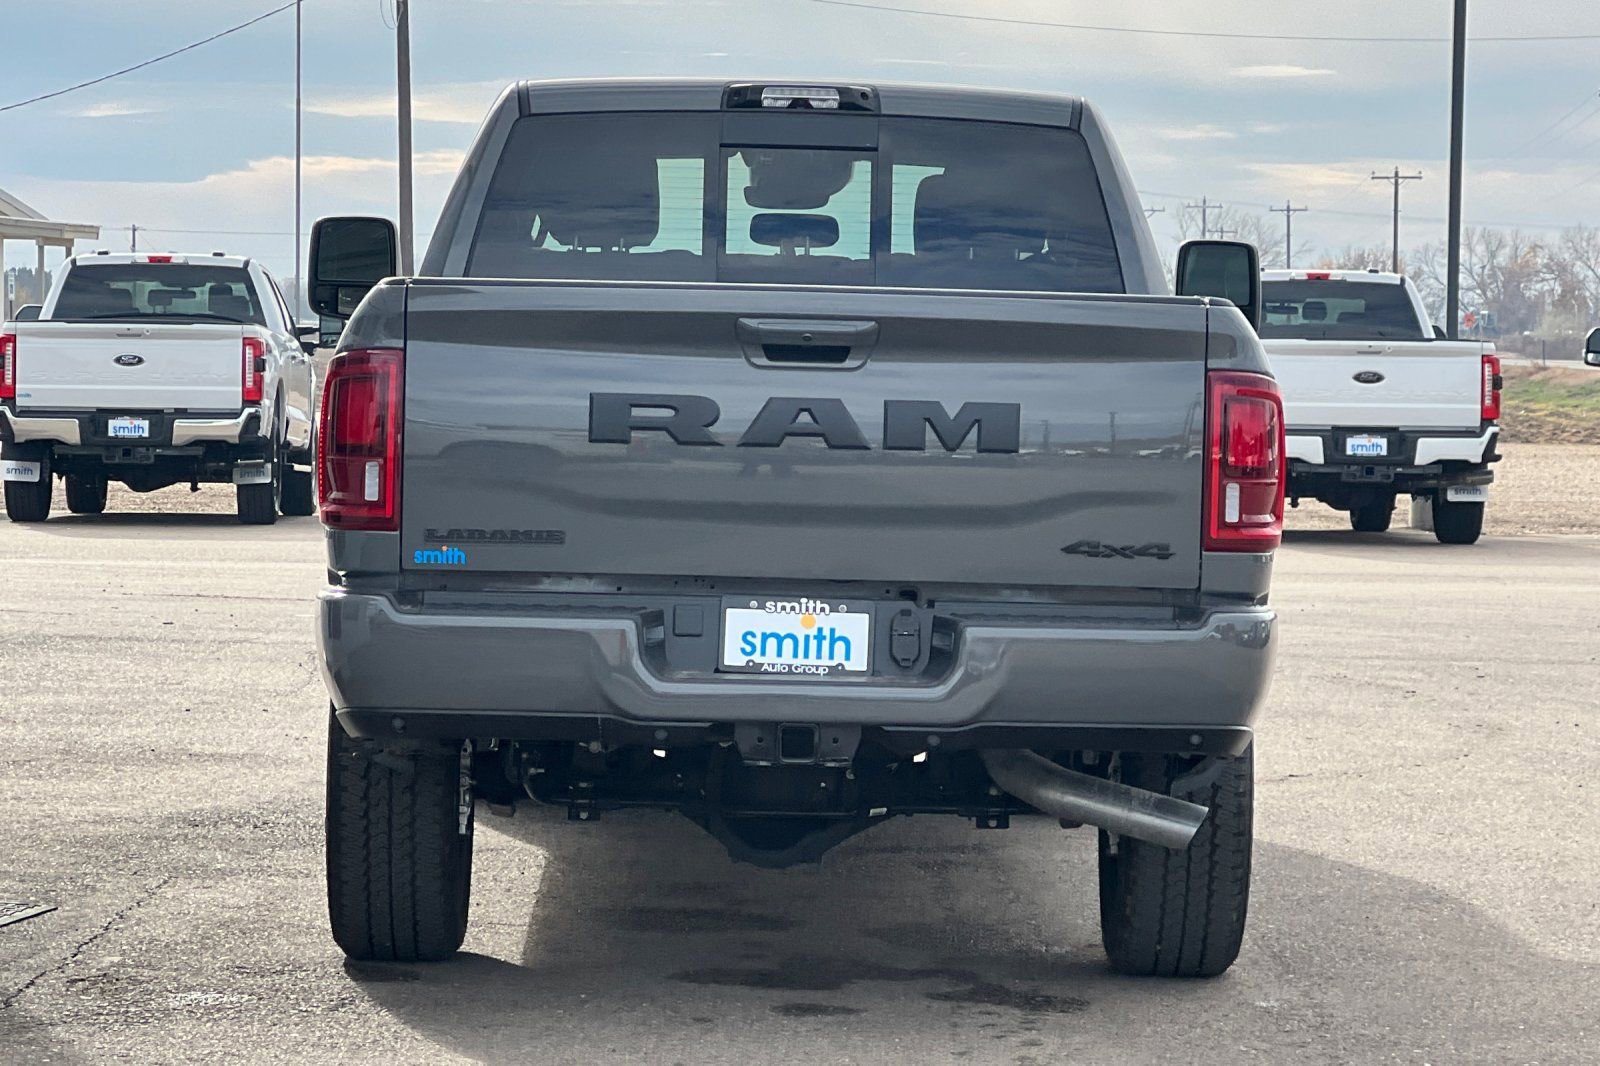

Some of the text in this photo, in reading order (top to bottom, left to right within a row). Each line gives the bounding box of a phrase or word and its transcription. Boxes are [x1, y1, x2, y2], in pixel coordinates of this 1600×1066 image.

[112, 420, 145, 434] smith
[589, 393, 1021, 453] RAM
[1351, 439, 1383, 452] smith
[6, 466, 33, 475] smith
[1454, 486, 1482, 495] smith
[424, 528, 566, 544] LARAMIE
[413, 545, 466, 564] smith
[765, 598, 830, 615] smith
[740, 617, 851, 661] smith
[761, 662, 829, 676] Auto Group
